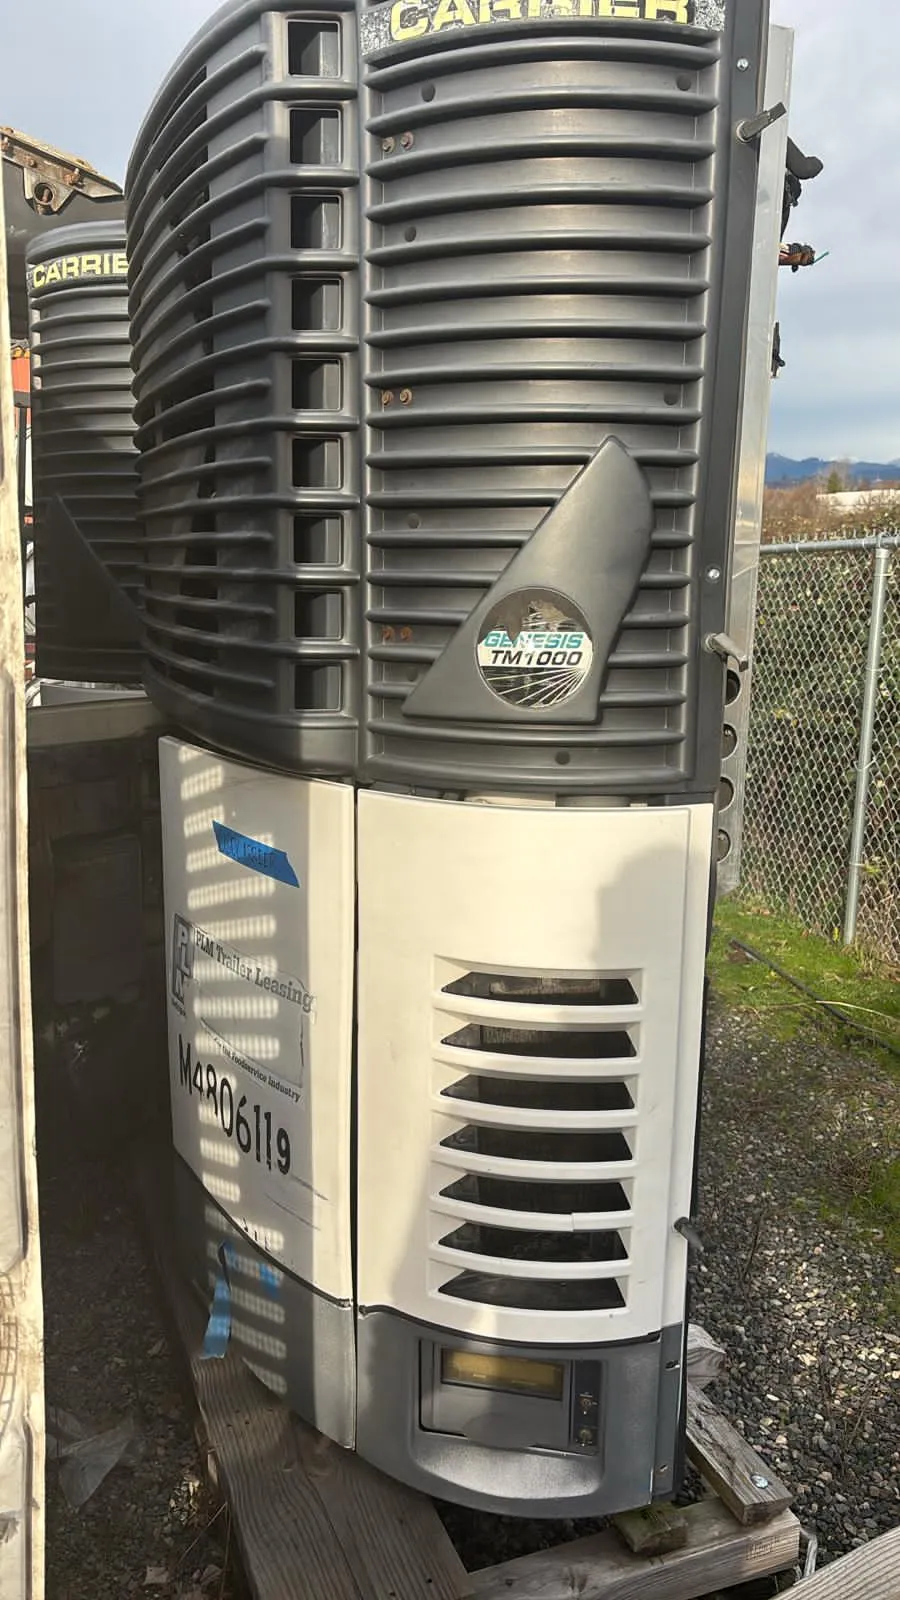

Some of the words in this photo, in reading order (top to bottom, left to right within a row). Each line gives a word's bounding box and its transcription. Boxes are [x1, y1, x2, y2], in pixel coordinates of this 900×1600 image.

[33, 252, 128, 288] CARRIE
[491, 650, 583, 666] TM1000
[196, 929, 214, 957] PLM
[216, 943, 253, 981] Trailer
[255, 967, 314, 1013] Leasing
[179, 1033, 291, 1175] M4806119
[268, 1075, 301, 1102] Industry
